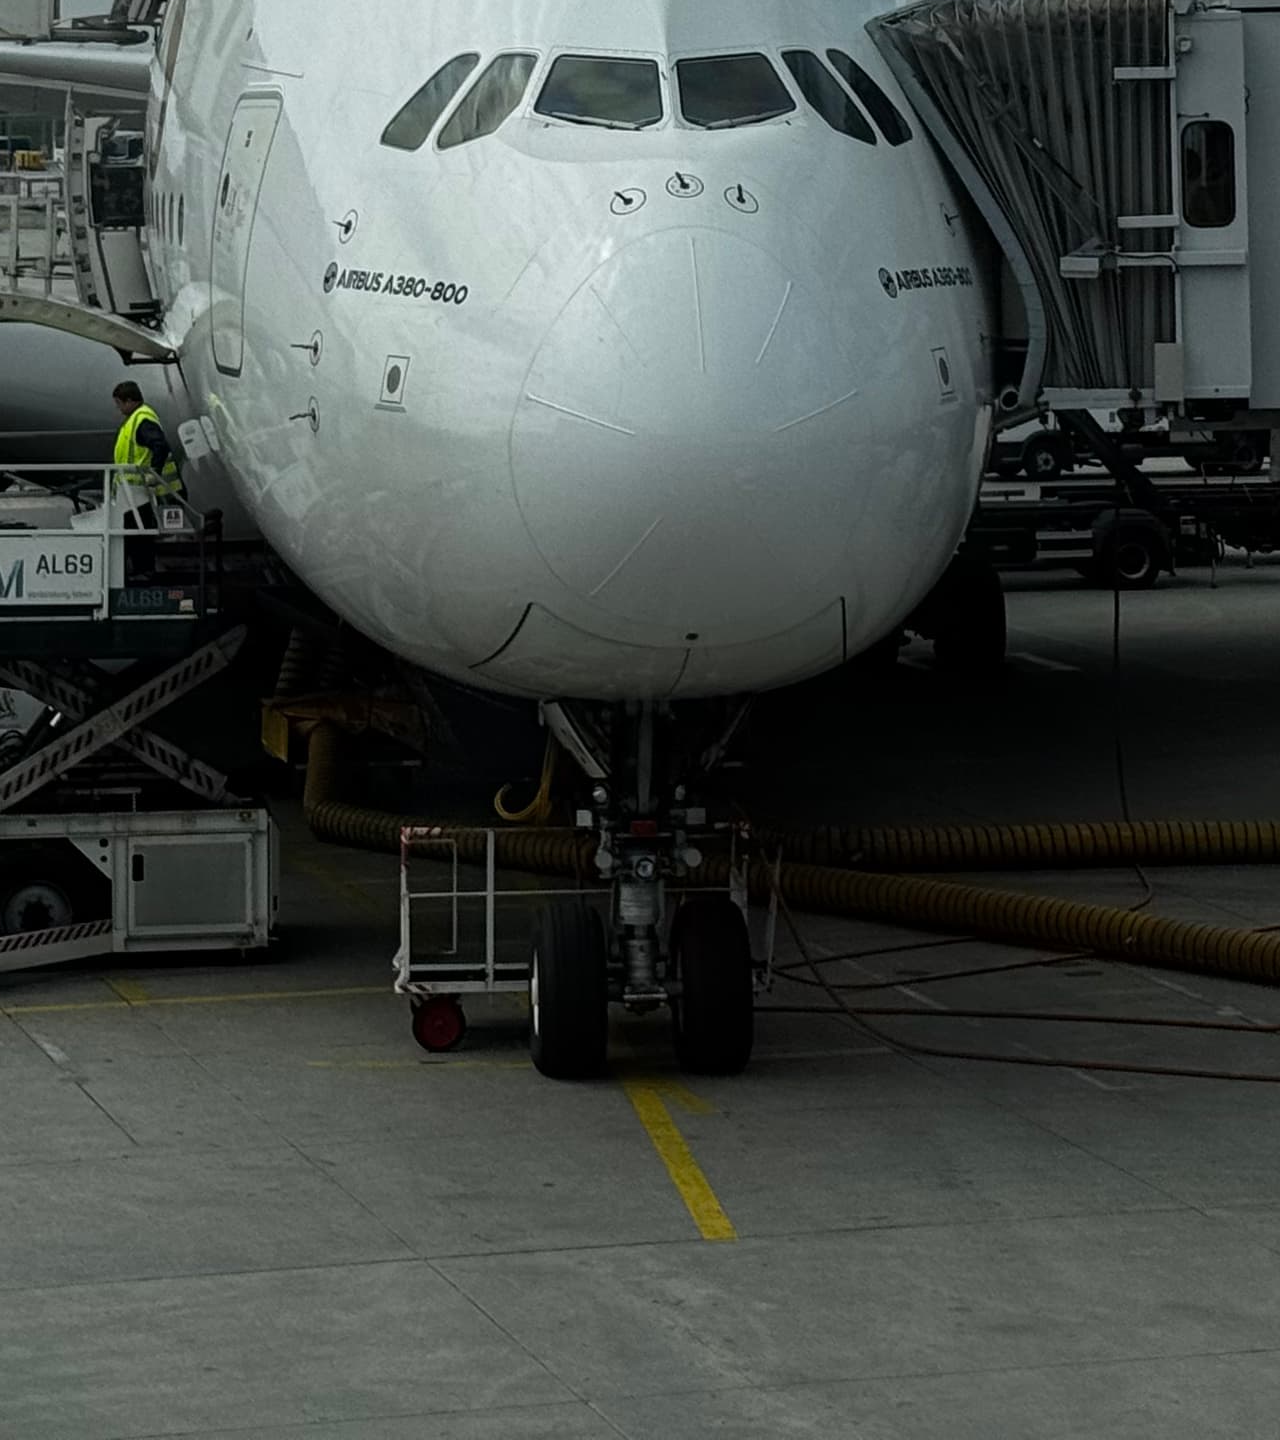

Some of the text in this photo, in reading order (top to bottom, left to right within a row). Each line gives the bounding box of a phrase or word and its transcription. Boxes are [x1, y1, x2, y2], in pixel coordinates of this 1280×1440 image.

[336, 268, 468, 304] AIRBUS A380-800
[36, 553, 94, 575] AL69
